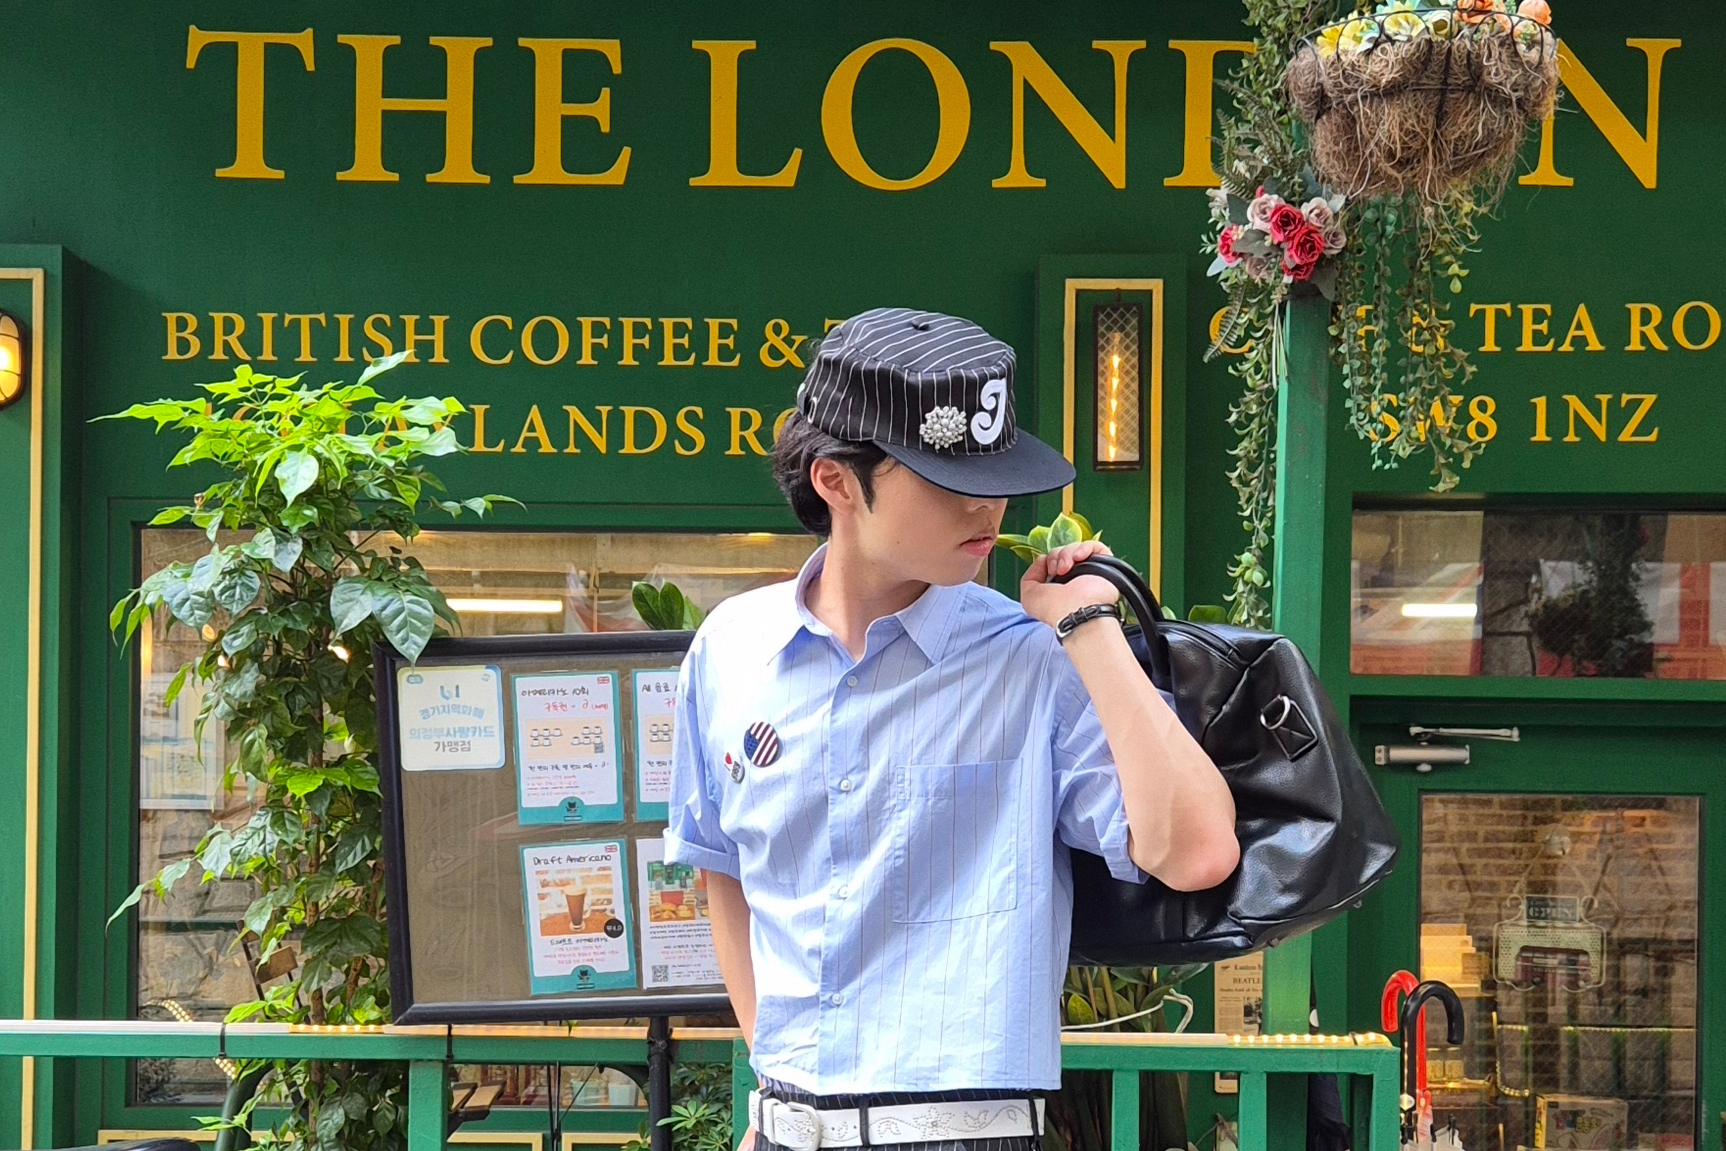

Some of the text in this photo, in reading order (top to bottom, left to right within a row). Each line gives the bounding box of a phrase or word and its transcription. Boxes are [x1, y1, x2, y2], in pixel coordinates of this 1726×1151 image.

[186, 25, 1682, 190] THE LONN
[163, 312, 808, 369] BRITISH COFFEE &
[1469, 303, 1604, 352] TEA
[1625, 301, 1722, 351] RO
[1530, 394, 1660, 443] 1NZ
[409, 726, 495, 739] 의정부사랑카드
[434, 740, 471, 752] 가맹점
[533, 854, 612, 866] Draft Americano
